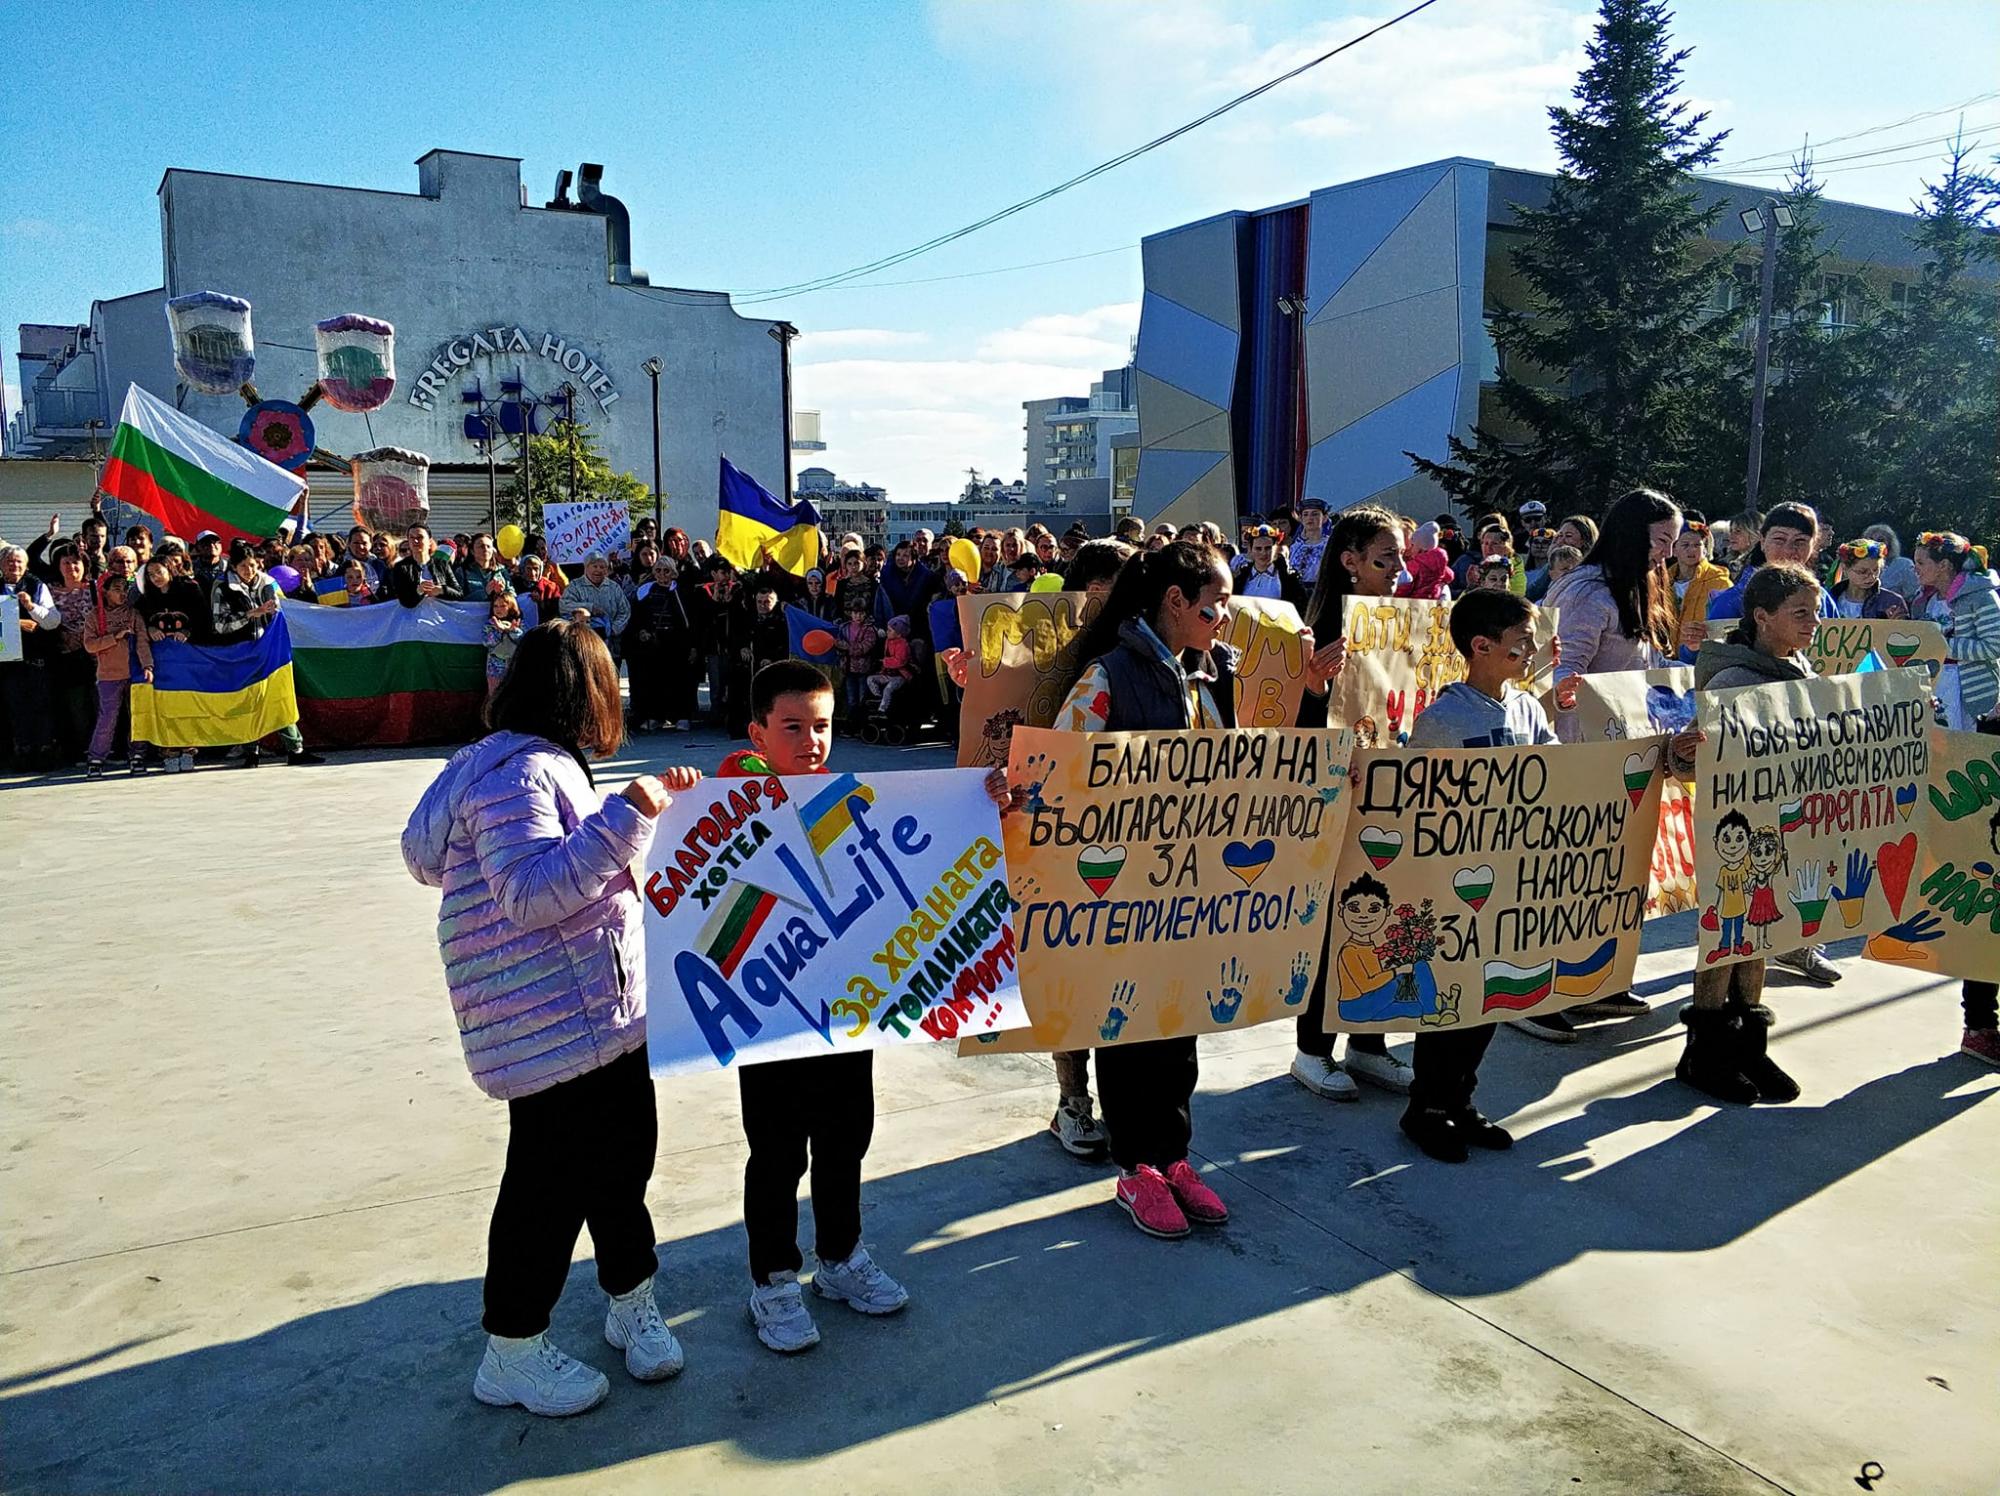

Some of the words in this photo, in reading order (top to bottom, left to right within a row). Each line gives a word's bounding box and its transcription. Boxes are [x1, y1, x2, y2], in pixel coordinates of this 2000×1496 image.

[408, 327, 531, 412] FREGATA
[539, 332, 620, 415] HOTEL
[545, 502, 614, 531] БЛАГОДАРЯ
[1803, 624, 1873, 660] АСКА
[1088, 735, 1267, 789] БЛАГОДАРЯ
[1271, 735, 1319, 785] НА
[1357, 753, 1548, 818] ДЯКУЄМО
[1752, 764, 1789, 805] ДА
[1243, 793, 1326, 842] НАРОД
[1413, 798, 1628, 858] БОЛГАРСЬКОМУ
[643, 774, 790, 918] БЛАГОДАРЯ
[690, 819, 773, 911] ХОТЕЛ
[1148, 842, 1199, 889] ЗА
[1515, 845, 1626, 903] НАРОДУ
[1019, 885, 1297, 953] ГОСТЕПРИЕМСТВО!
[1438, 914, 1481, 962] ЗА
